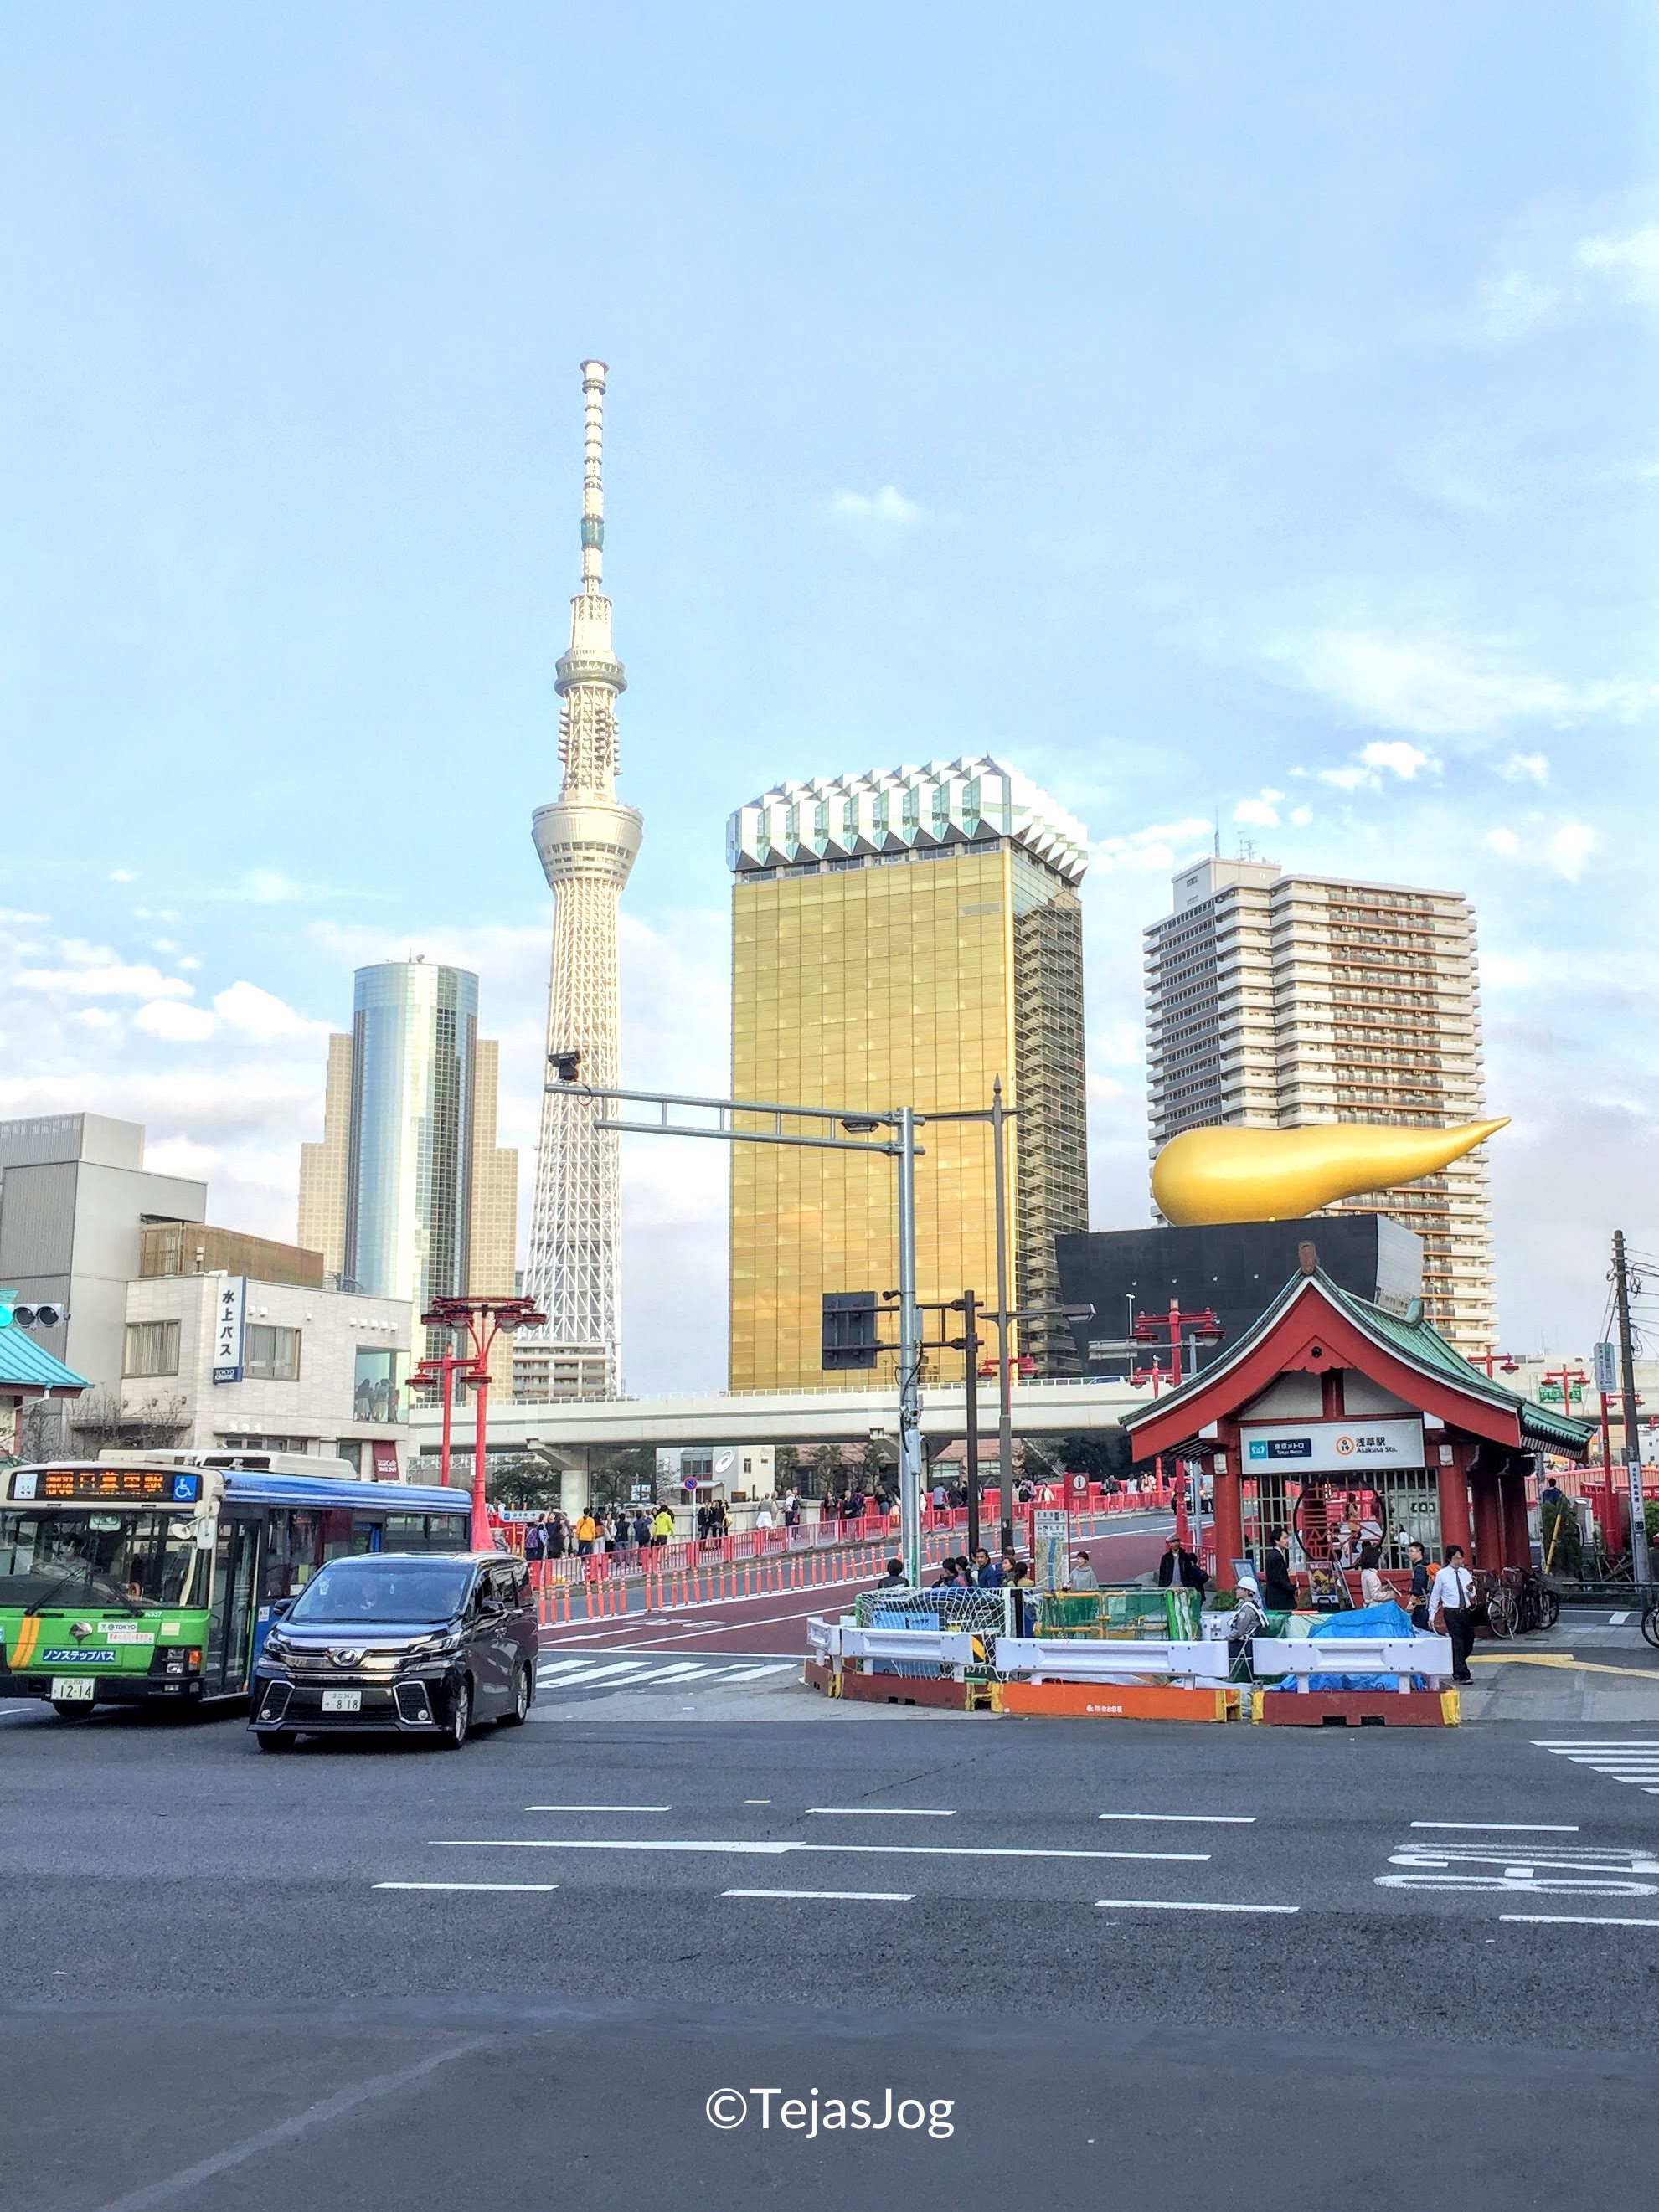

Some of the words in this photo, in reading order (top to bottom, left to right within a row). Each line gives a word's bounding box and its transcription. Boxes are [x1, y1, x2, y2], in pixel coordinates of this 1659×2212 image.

[219, 1290, 234, 1356] 水上バス
[1357, 1437, 1386, 1447] 浅草駅
[43, 1650, 115, 1661] ノンステップバス
